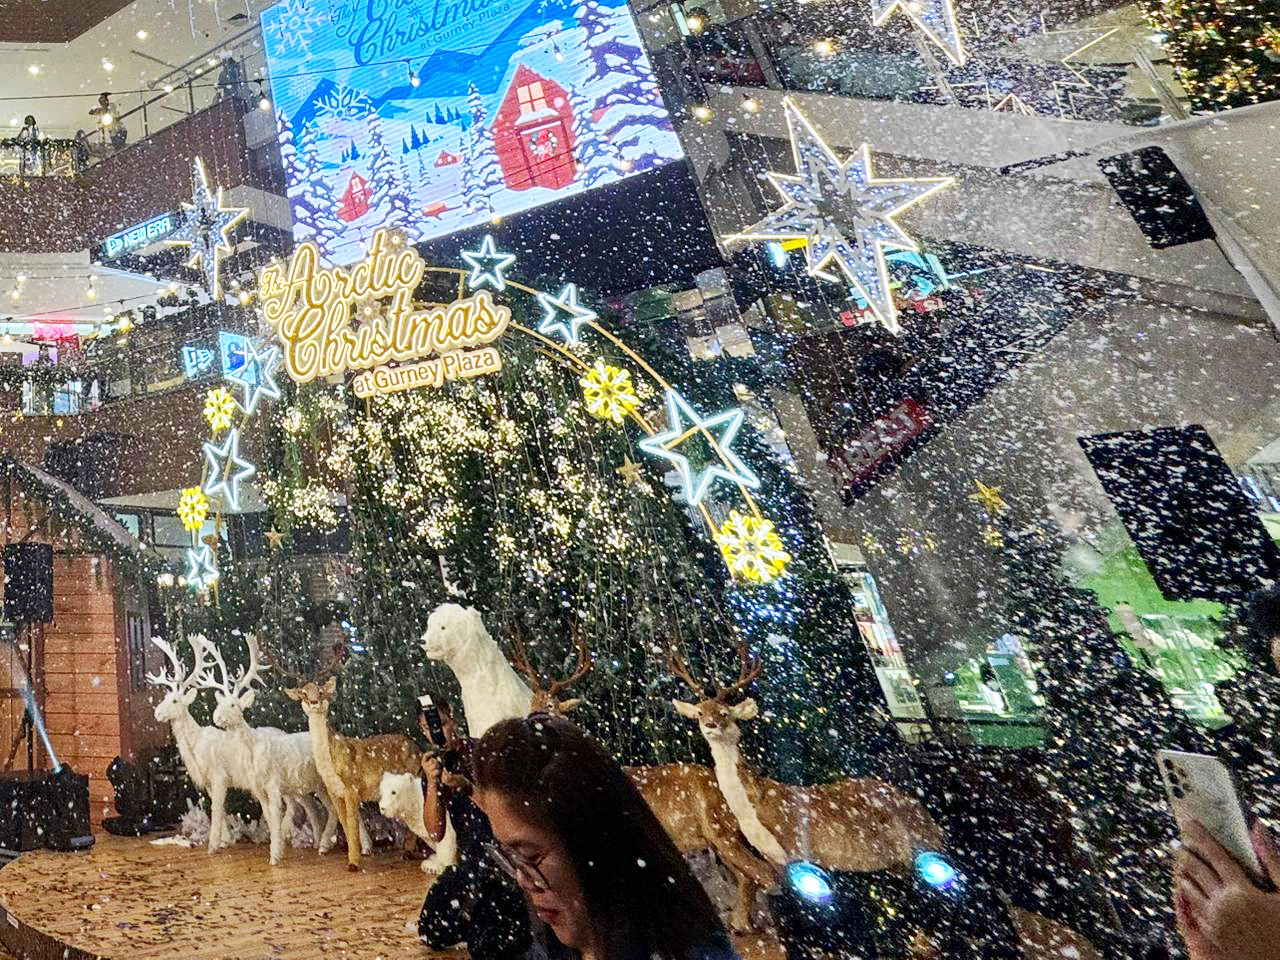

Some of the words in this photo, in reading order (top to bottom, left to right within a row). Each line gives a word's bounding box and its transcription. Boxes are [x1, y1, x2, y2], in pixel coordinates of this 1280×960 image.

[332, 4, 354, 25] The
[420, 38, 433, 49] at
[433, 20, 477, 48] Gurney
[478, 2, 511, 23] Plaza
[123, 225, 147, 248] NEW
[146, 217, 171, 240] ERA
[260, 264, 288, 297] The
[264, 228, 422, 320] Arctic
[279, 287, 506, 378] Christmas
[354, 374, 371, 394] at
[374, 363, 441, 390] Gurney
[444, 350, 496, 376] Plaza
